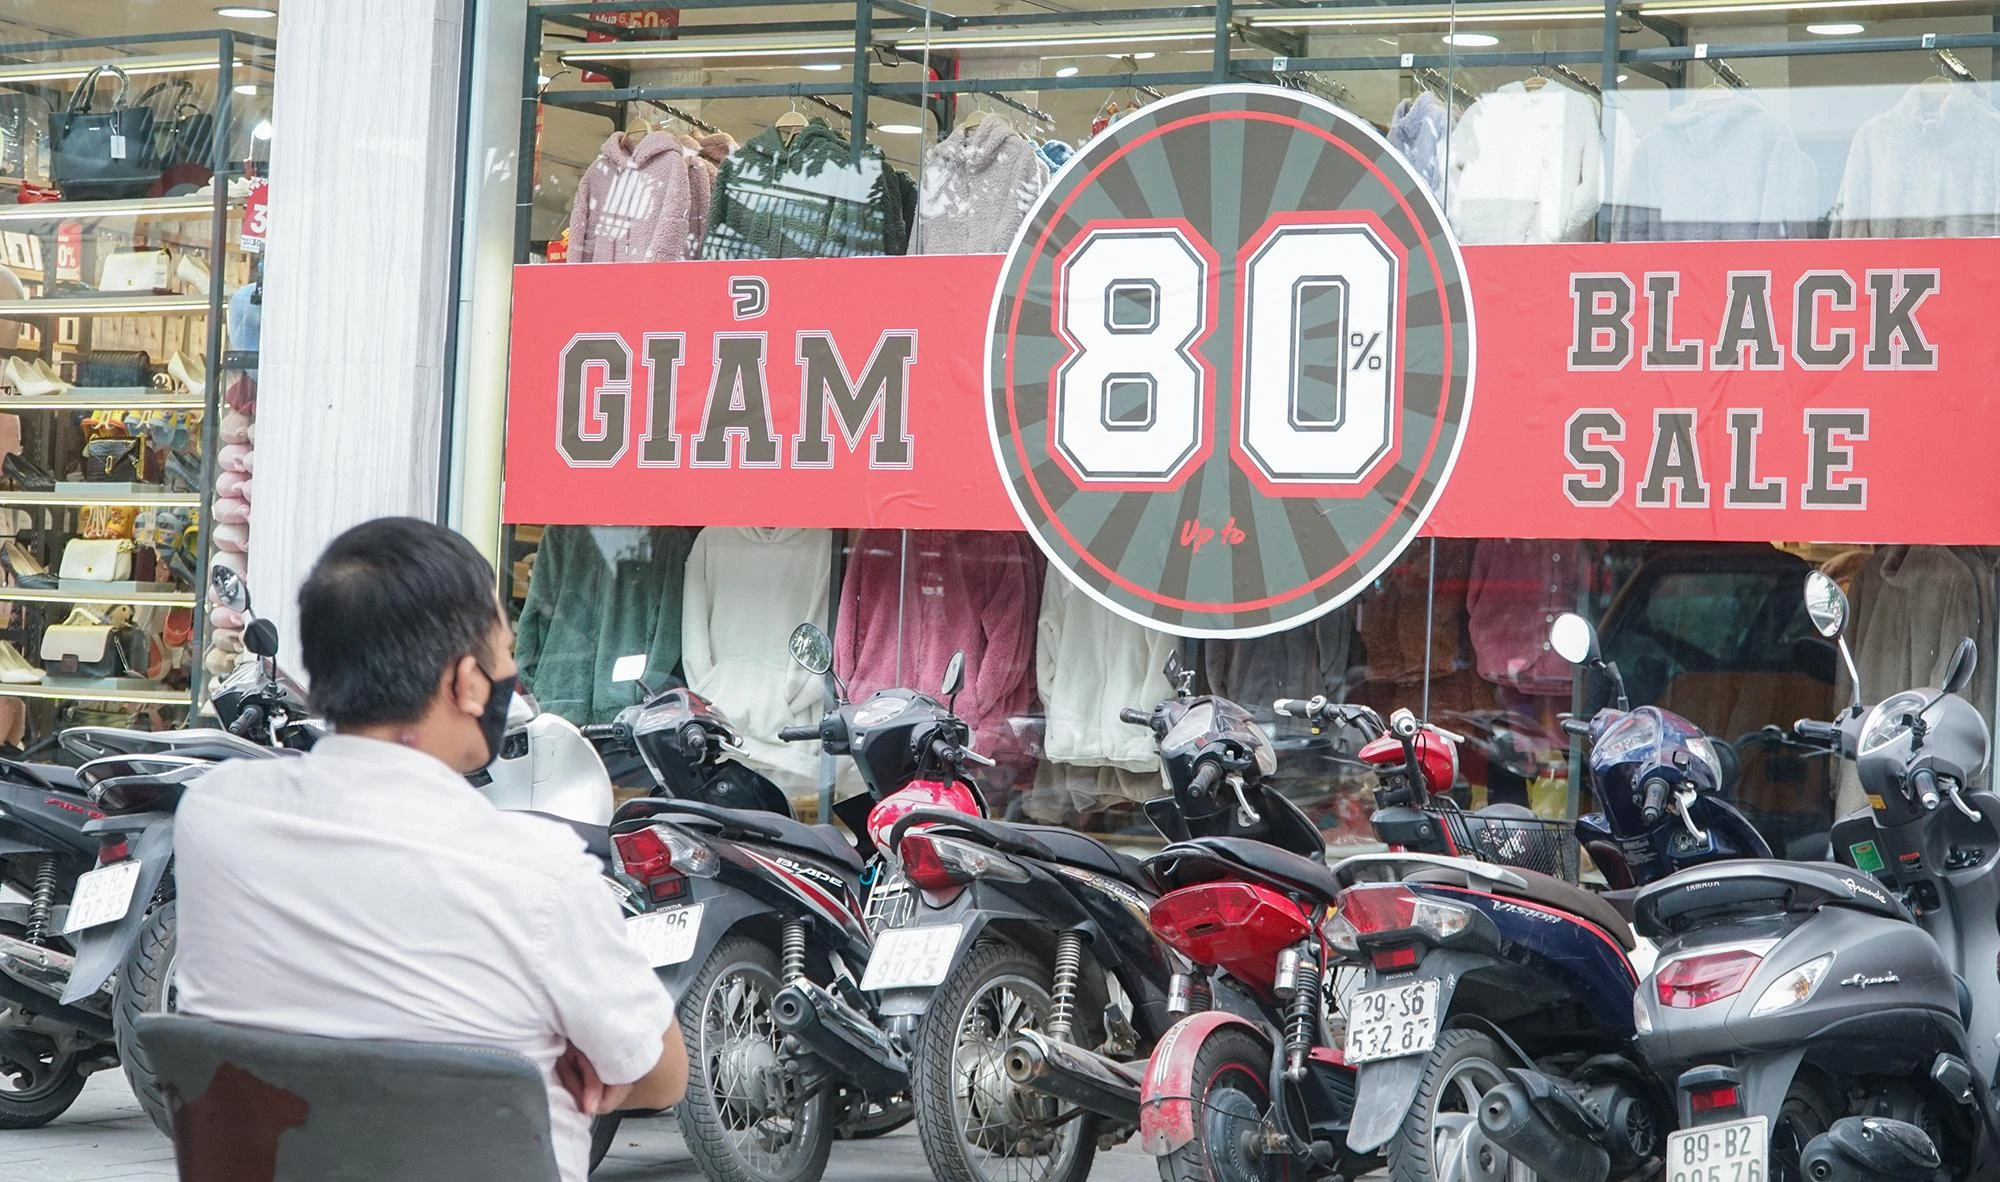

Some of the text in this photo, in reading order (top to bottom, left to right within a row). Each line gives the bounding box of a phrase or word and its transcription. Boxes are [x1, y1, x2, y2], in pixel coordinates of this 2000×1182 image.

[1567, 268, 1941, 372] BLACK
[555, 275, 918, 470] GIẢM
[1563, 407, 1870, 511] SALE
[1180, 516, 1246, 554] Up to
[776, 857, 843, 888] BLADE
[1683, 1125, 1752, 1166] 89-B2
